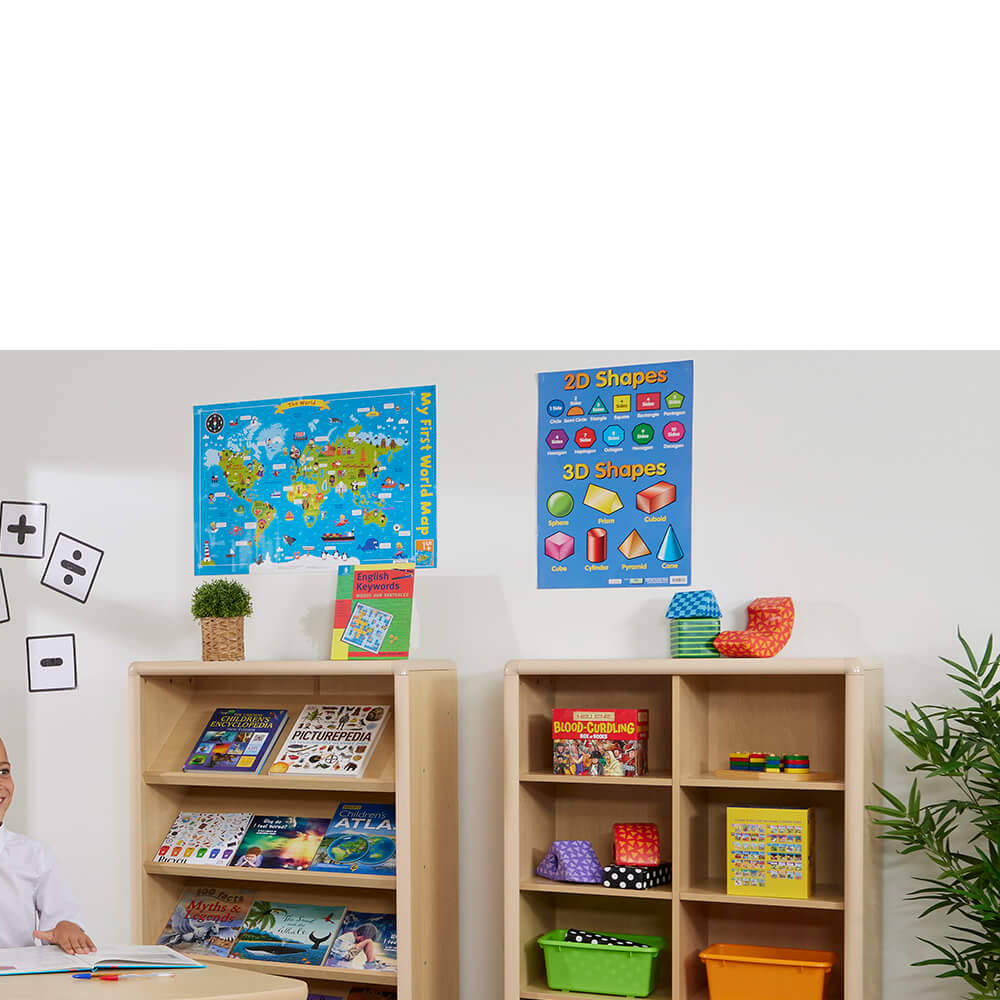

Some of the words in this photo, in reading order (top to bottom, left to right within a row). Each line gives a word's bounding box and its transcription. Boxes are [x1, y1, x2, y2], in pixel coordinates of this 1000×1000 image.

[564, 373, 590, 390] 2D
[596, 369, 667, 389] Shapes
[416, 392, 432, 414] My
[420, 420, 432, 450] First
[420, 455, 433, 497] World
[563, 463, 589, 480] 3D
[595, 461, 666, 482] Shapes
[416, 501, 432, 535] Map
[357, 572, 389, 582] English
[357, 582, 400, 592] Keywords
[553, 721, 635, 734] BLOOD-CURDLING
[292, 731, 372, 741] PICTUREPEDIA
[339, 810, 386, 818] Children's
[334, 818, 396, 830] ATLA
[187, 900, 226, 912] Myths
[230, 904, 240, 913] &
[184, 910, 233, 922] Legends
